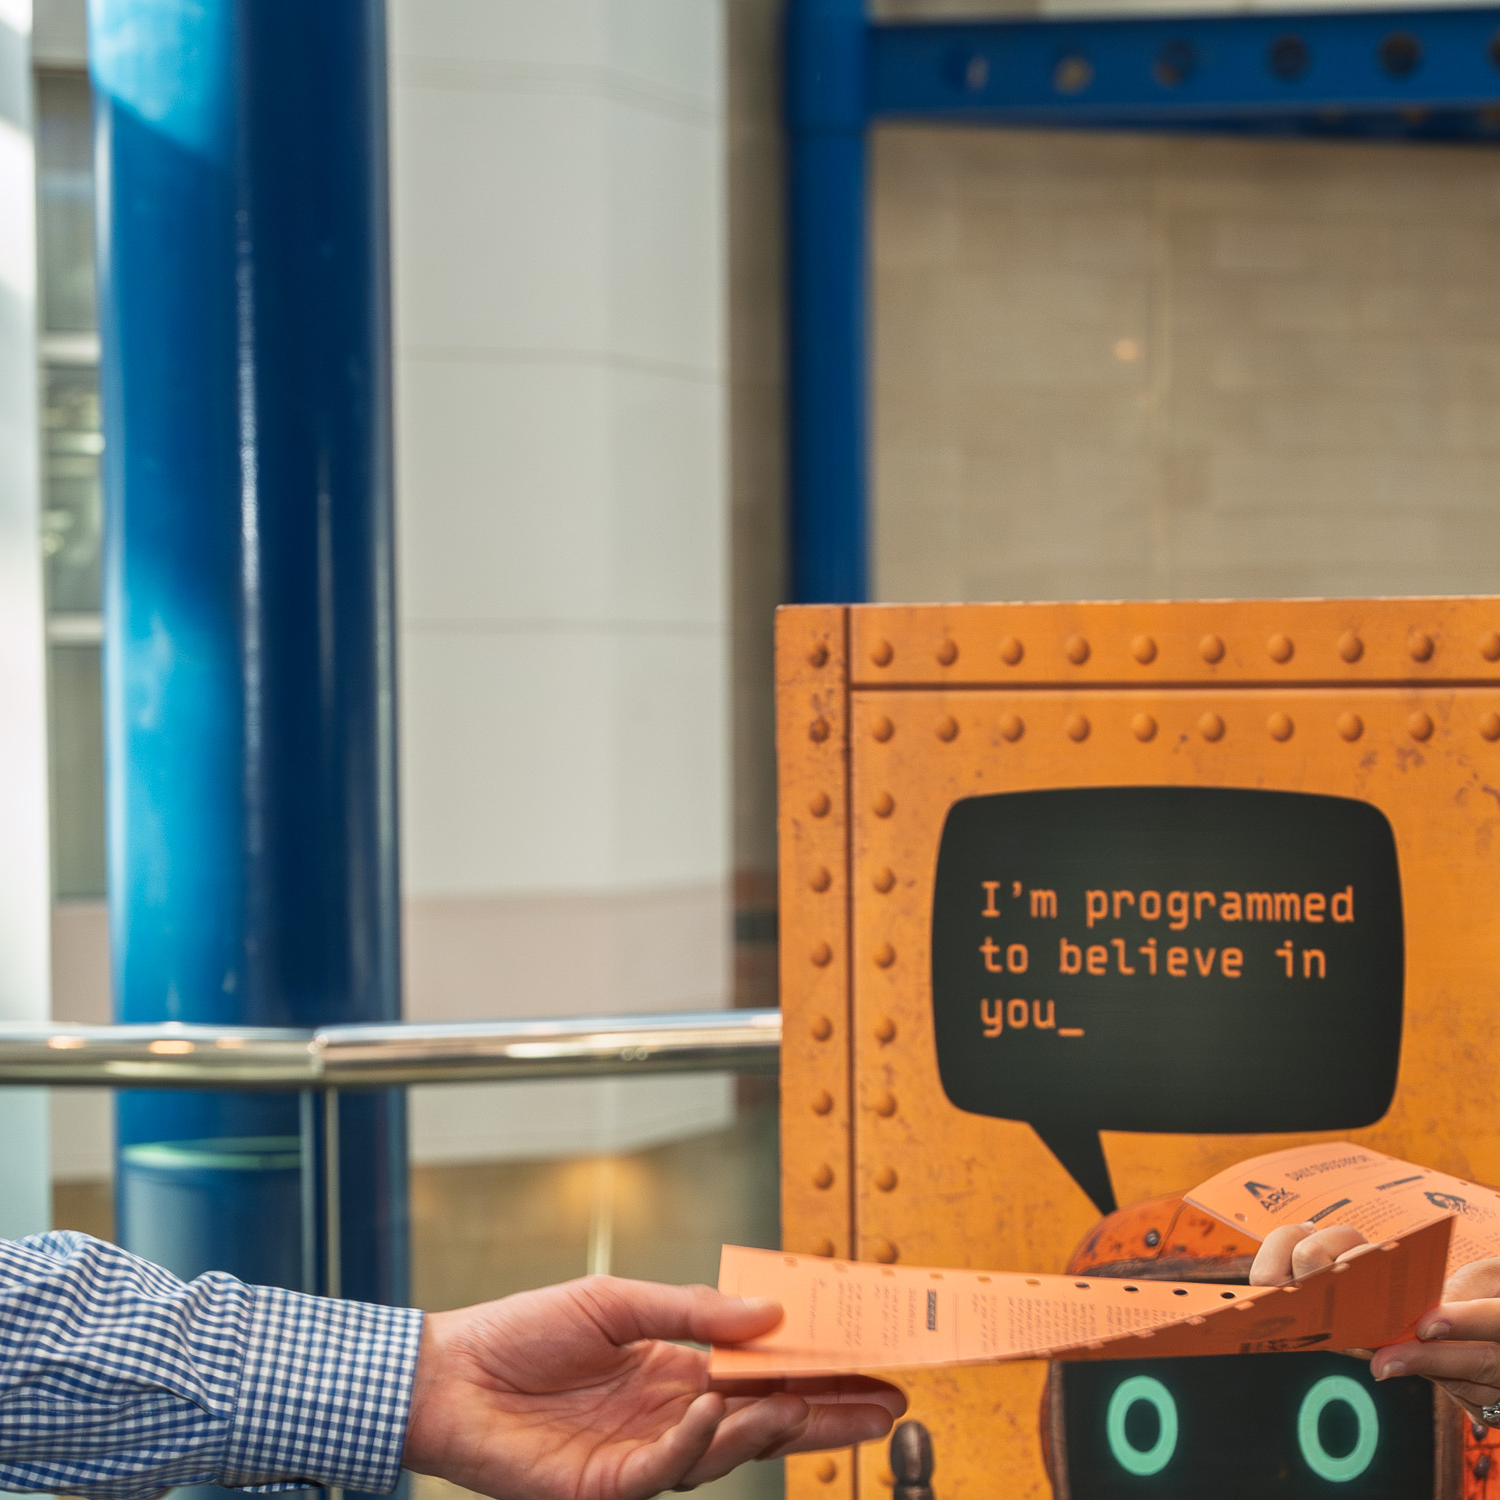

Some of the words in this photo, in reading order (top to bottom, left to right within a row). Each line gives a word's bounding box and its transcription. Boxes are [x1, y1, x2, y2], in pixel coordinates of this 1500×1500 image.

[1086, 885, 1355, 930] programmed
[979, 936, 1029, 974] to
[1059, 937, 1244, 978] believe
[1275, 940, 1326, 978] in
